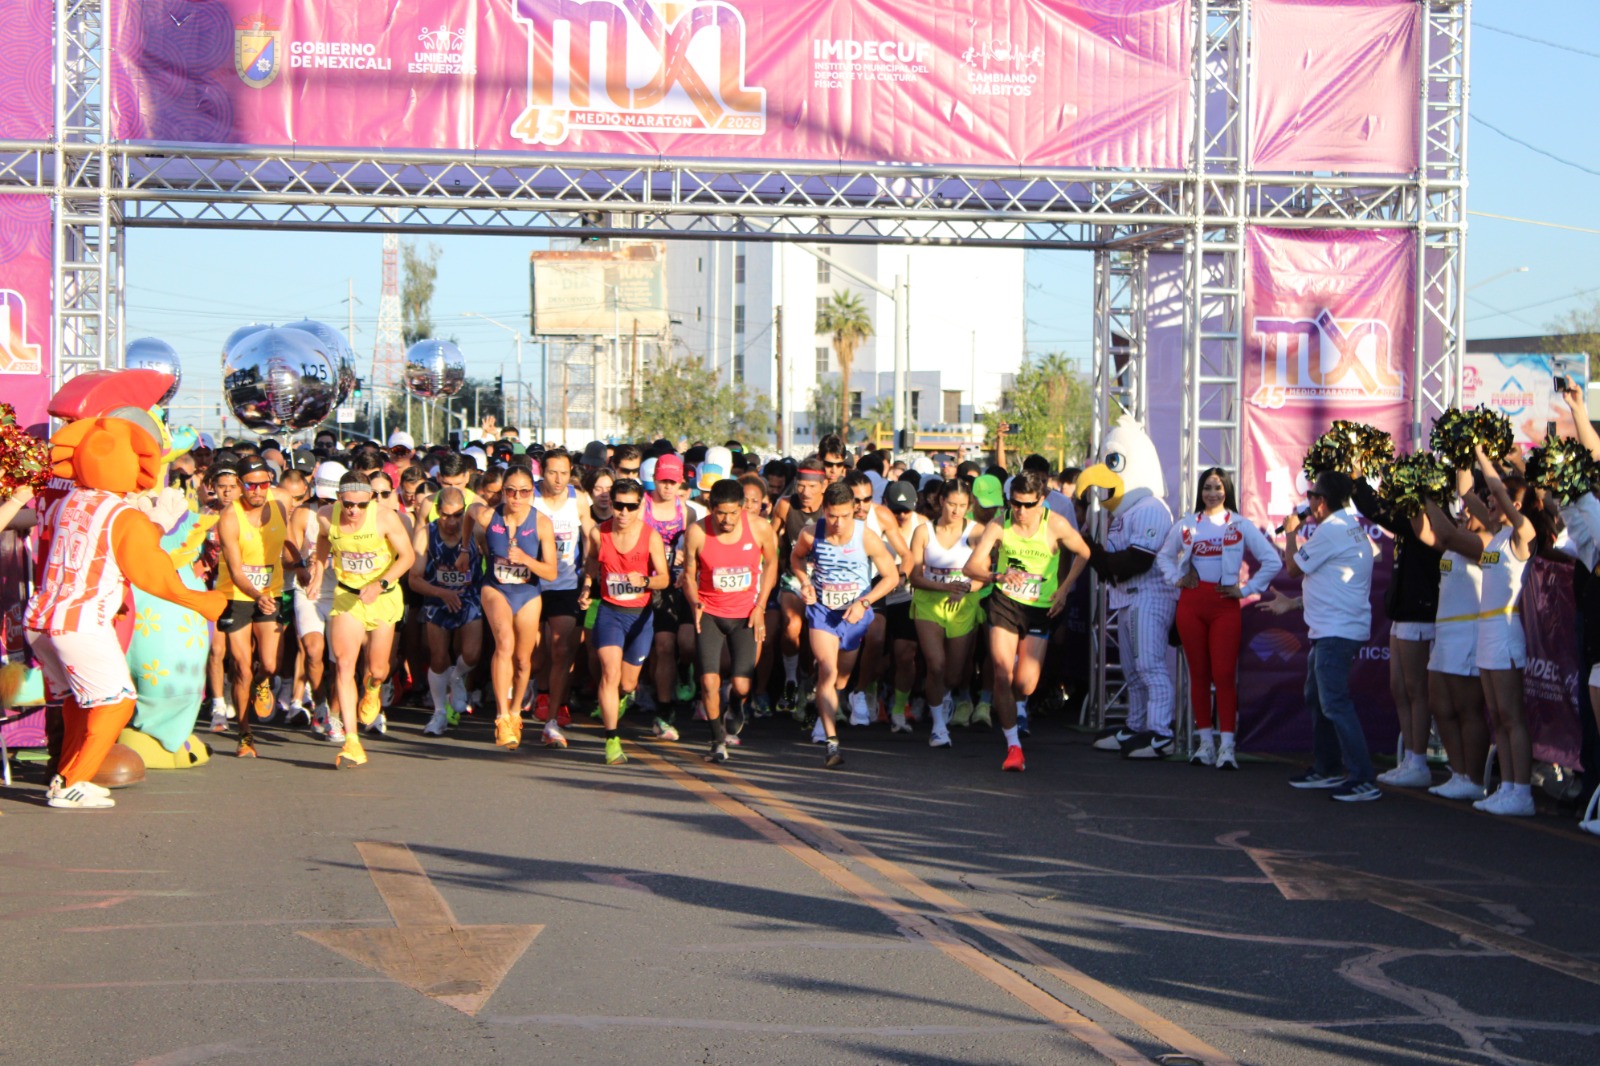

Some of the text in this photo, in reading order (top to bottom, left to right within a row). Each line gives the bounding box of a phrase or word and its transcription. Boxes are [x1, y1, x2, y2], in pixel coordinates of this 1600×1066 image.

[291, 41, 376, 56] GOBIERNO
[814, 39, 931, 63] IMDECUF
[291, 56, 392, 70] DE MEXICALI
[815, 63, 929, 74] INSTITUTO MUNICIPAL DEL
[815, 72, 855, 80] DEPORTE
[877, 74, 917, 82] CULTURA
[968, 73, 1037, 84] CAMBIANDO
[516, 109, 566, 140] 45
[575, 112, 761, 129] MEDIO MARATÓN 2026
[1255, 387, 1284, 406] 45
[1290, 388, 1316, 396] MEDIO
[347, 558, 373, 571] 970
[442, 572, 466, 583] 695
[497, 565, 530, 580] 1744
[720, 575, 745, 588] 537
[825, 591, 857, 606] 1567
